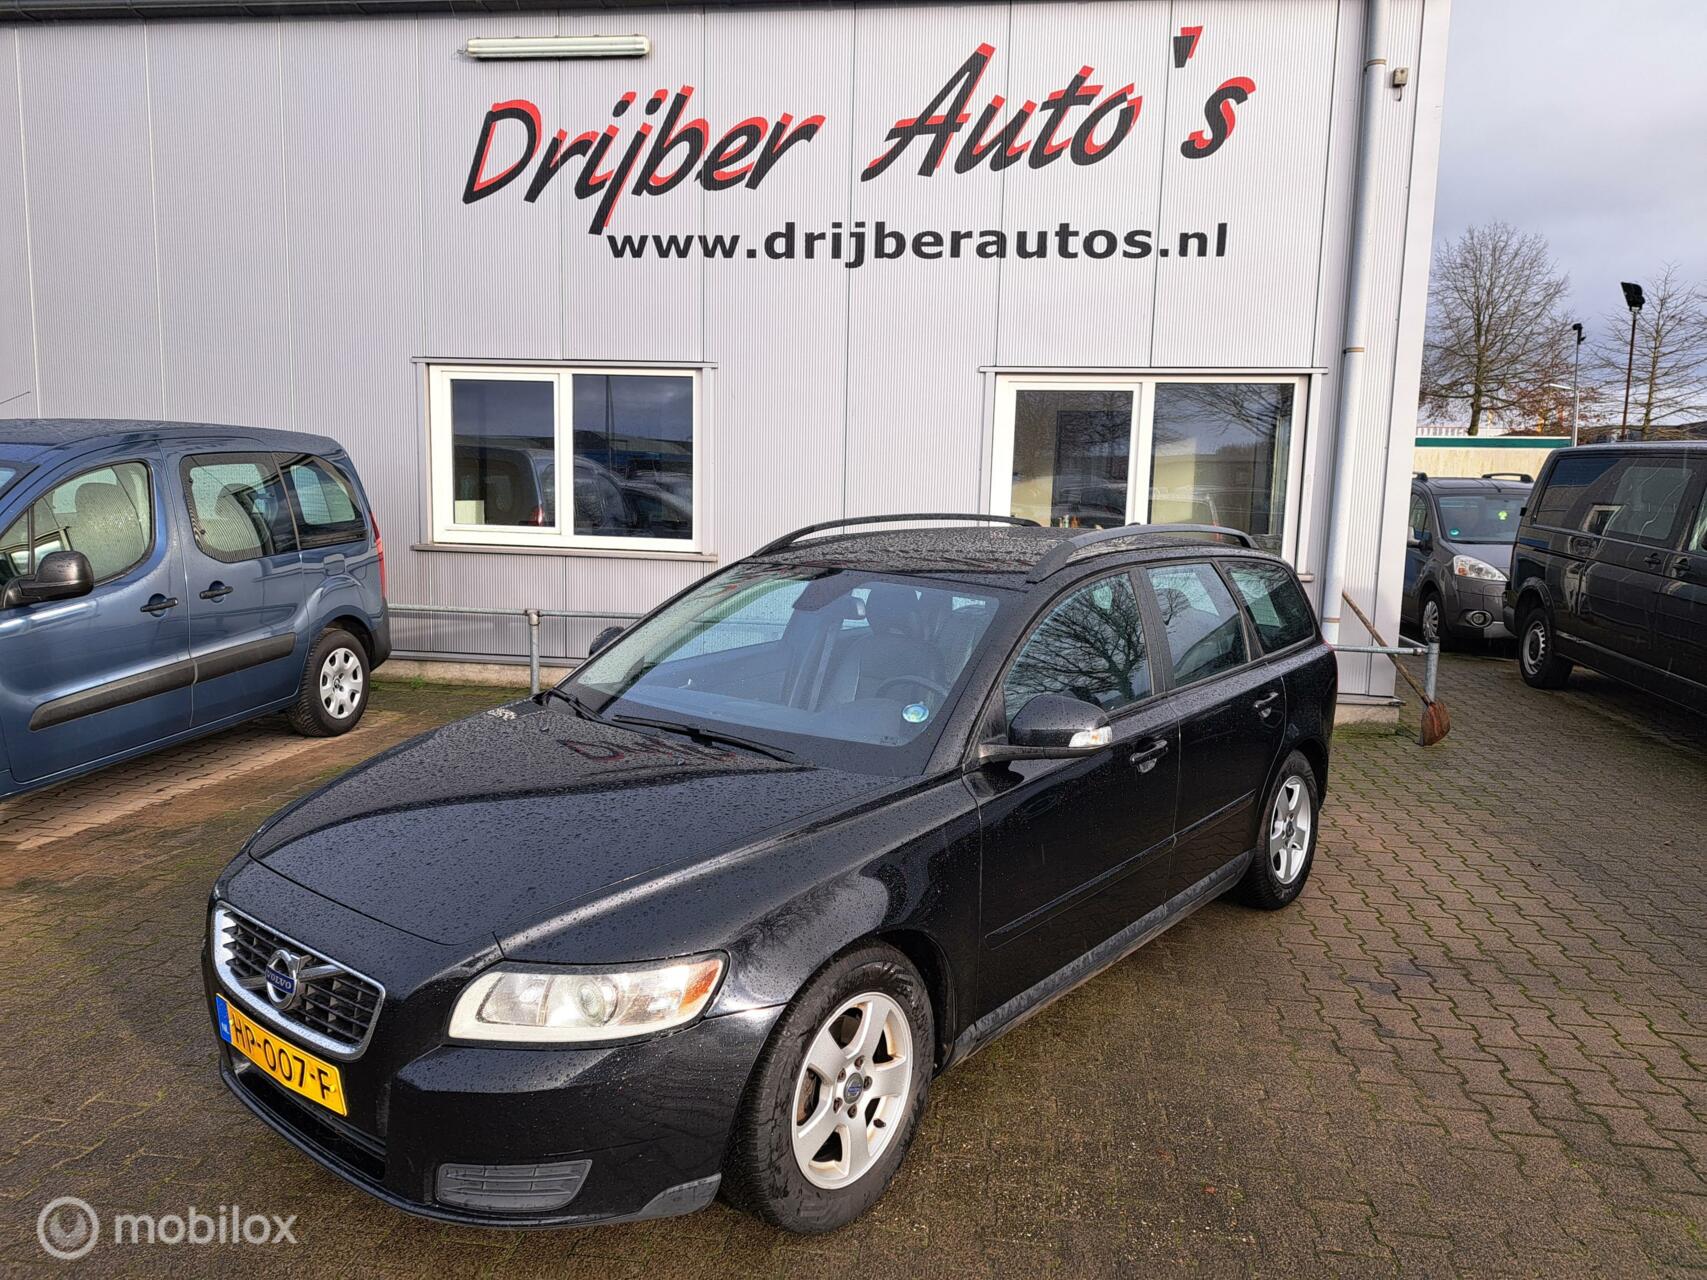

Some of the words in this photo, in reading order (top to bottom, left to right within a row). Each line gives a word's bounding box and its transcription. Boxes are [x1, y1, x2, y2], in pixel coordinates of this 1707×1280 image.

[463, 86, 826, 235] Drijber
[861, 26, 1256, 182] Auto's
[606, 222, 1228, 269] www.drijberautos.nl
[266, 969, 292, 989] VOLVO
[232, 1012, 332, 1100] HP-007-F
